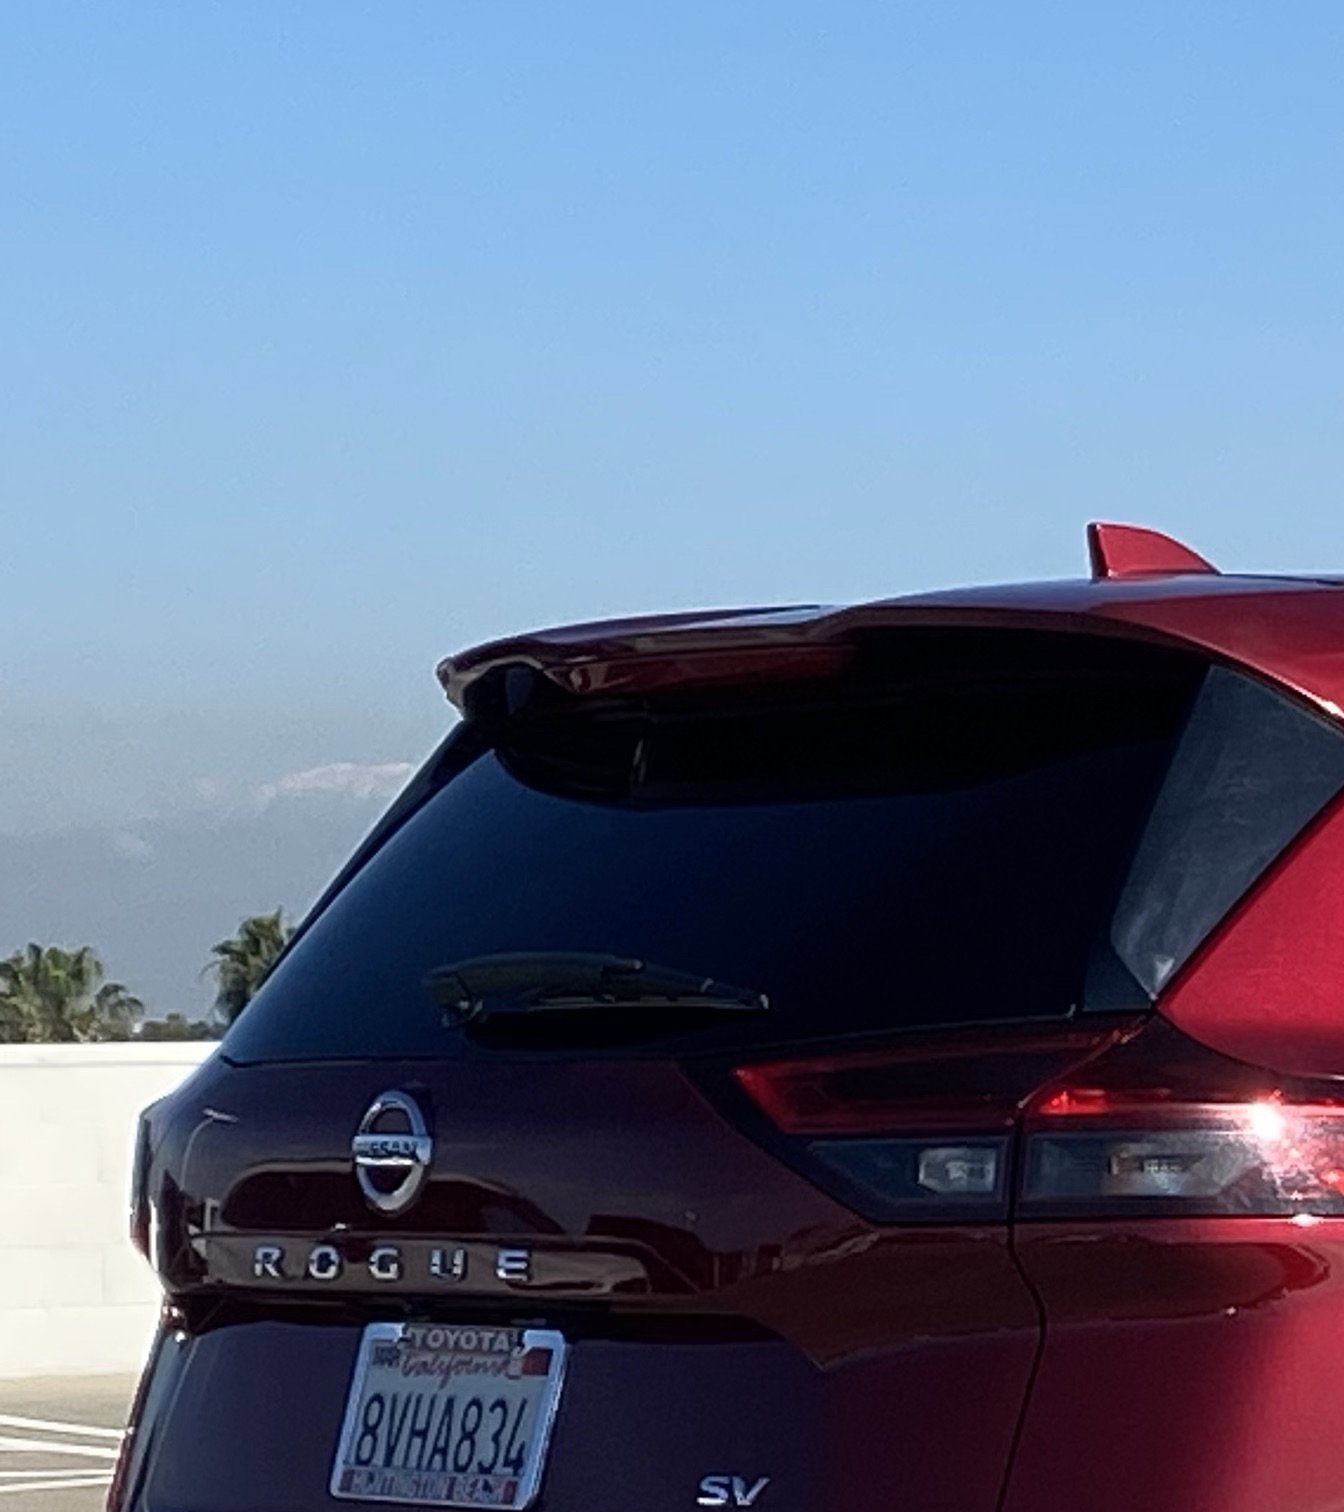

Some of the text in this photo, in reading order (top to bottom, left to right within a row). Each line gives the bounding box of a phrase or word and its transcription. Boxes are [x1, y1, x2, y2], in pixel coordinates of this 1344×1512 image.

[254, 1244, 529, 1281] ROGUE
[413, 1329, 510, 1353] TOYOTA
[354, 1392, 529, 1476] 8VHA834
[697, 1476, 770, 1506] SV
